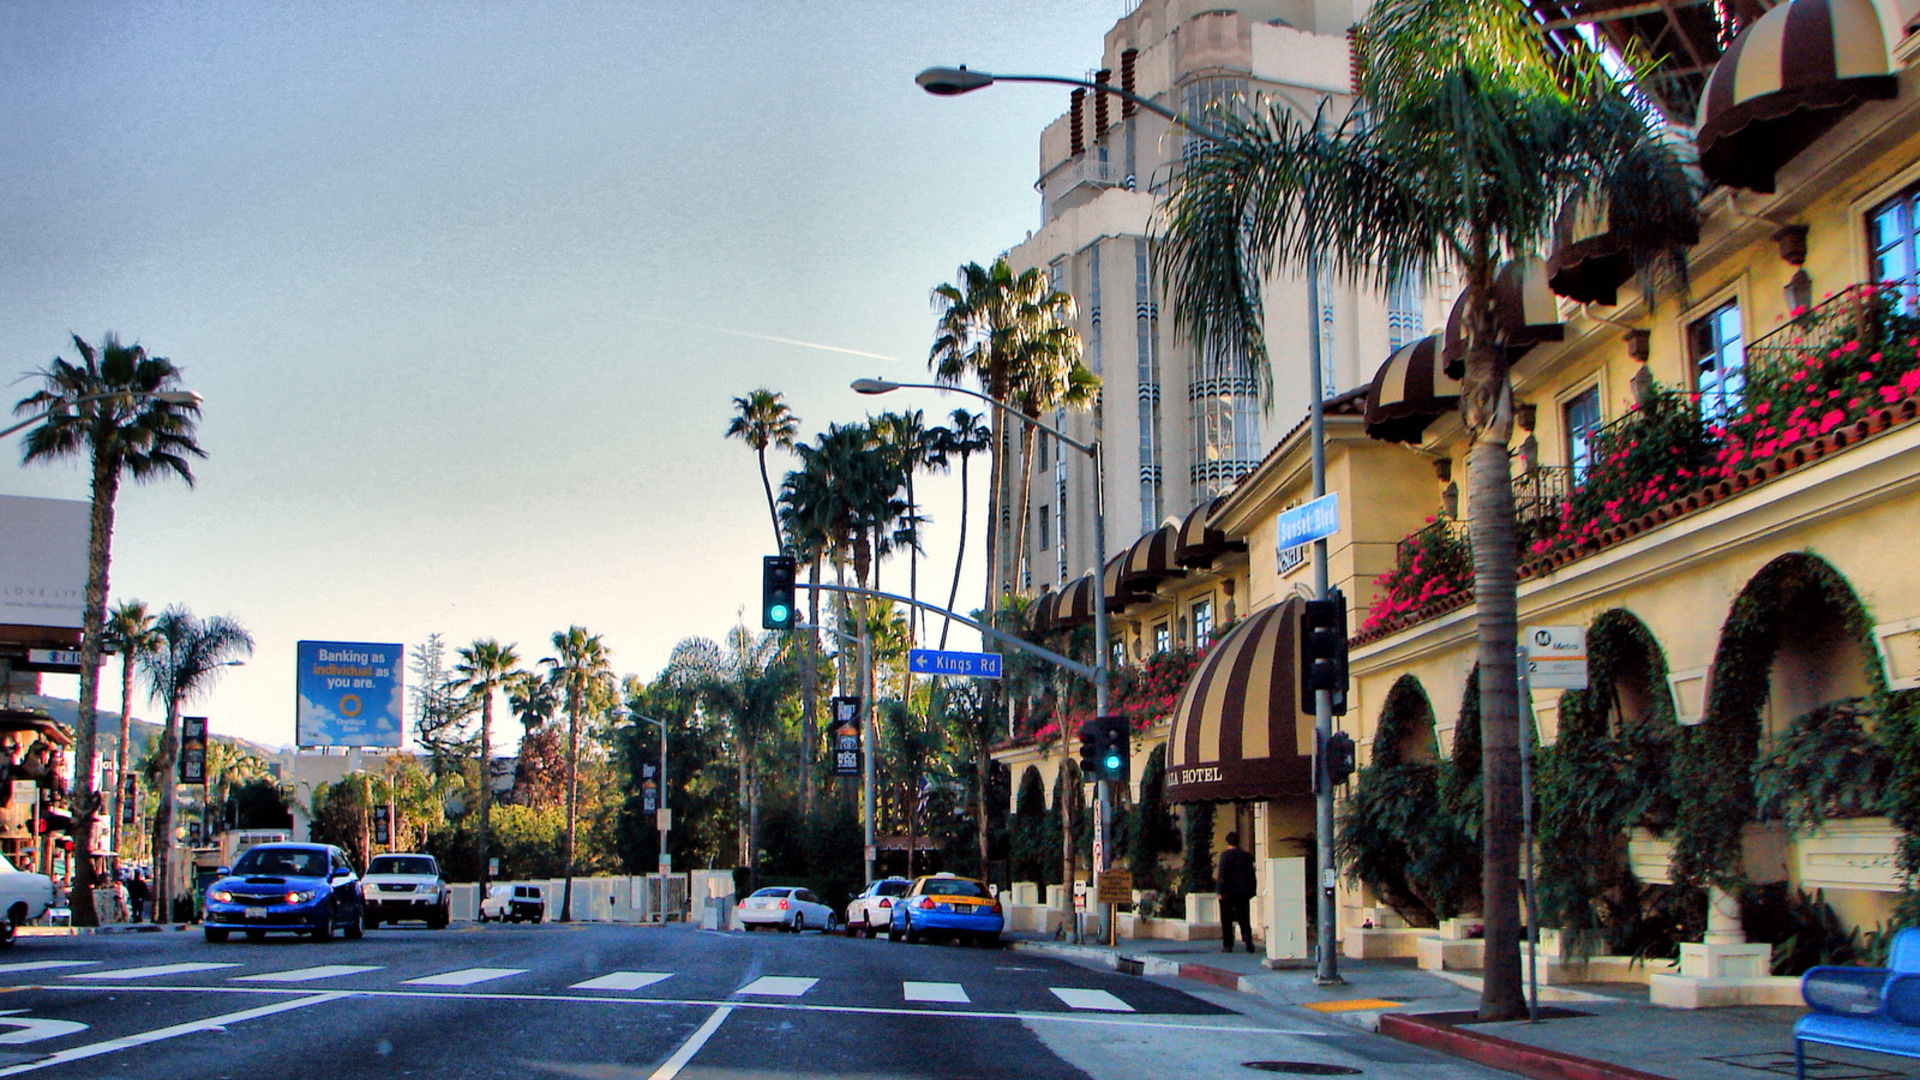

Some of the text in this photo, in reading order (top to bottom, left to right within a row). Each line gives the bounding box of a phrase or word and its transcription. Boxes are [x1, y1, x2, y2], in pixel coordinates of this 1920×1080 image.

[1281, 503, 1335, 542] Sunset Blvd
[5, 586, 45, 597] LOVE
[1553, 641, 1580, 650] Metro
[318, 648, 385, 666] Banking as
[936, 655, 996, 674] Kings Rd
[313, 663, 390, 678] individual as
[1529, 662, 1538, 673] 2
[327, 677, 376, 690] you are.
[1181, 767, 1223, 784] HOTEL
